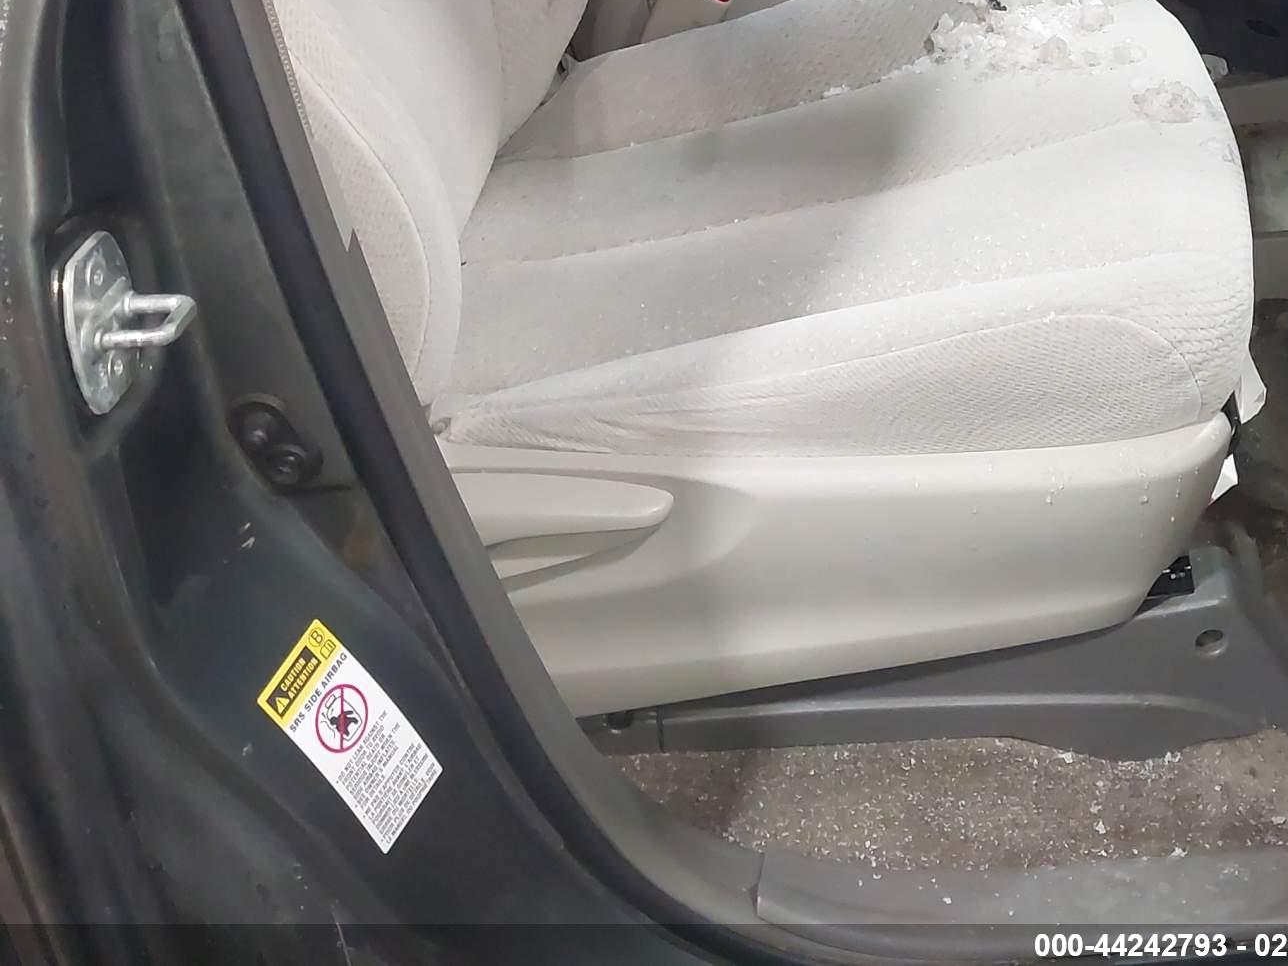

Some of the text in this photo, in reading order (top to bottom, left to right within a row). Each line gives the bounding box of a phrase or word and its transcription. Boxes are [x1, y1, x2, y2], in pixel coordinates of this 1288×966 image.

[280, 657, 306, 692] CAUTION
[287, 657, 319, 700] ATTENTION
[289, 652, 347, 733] SRS SIDE AIRBAG
